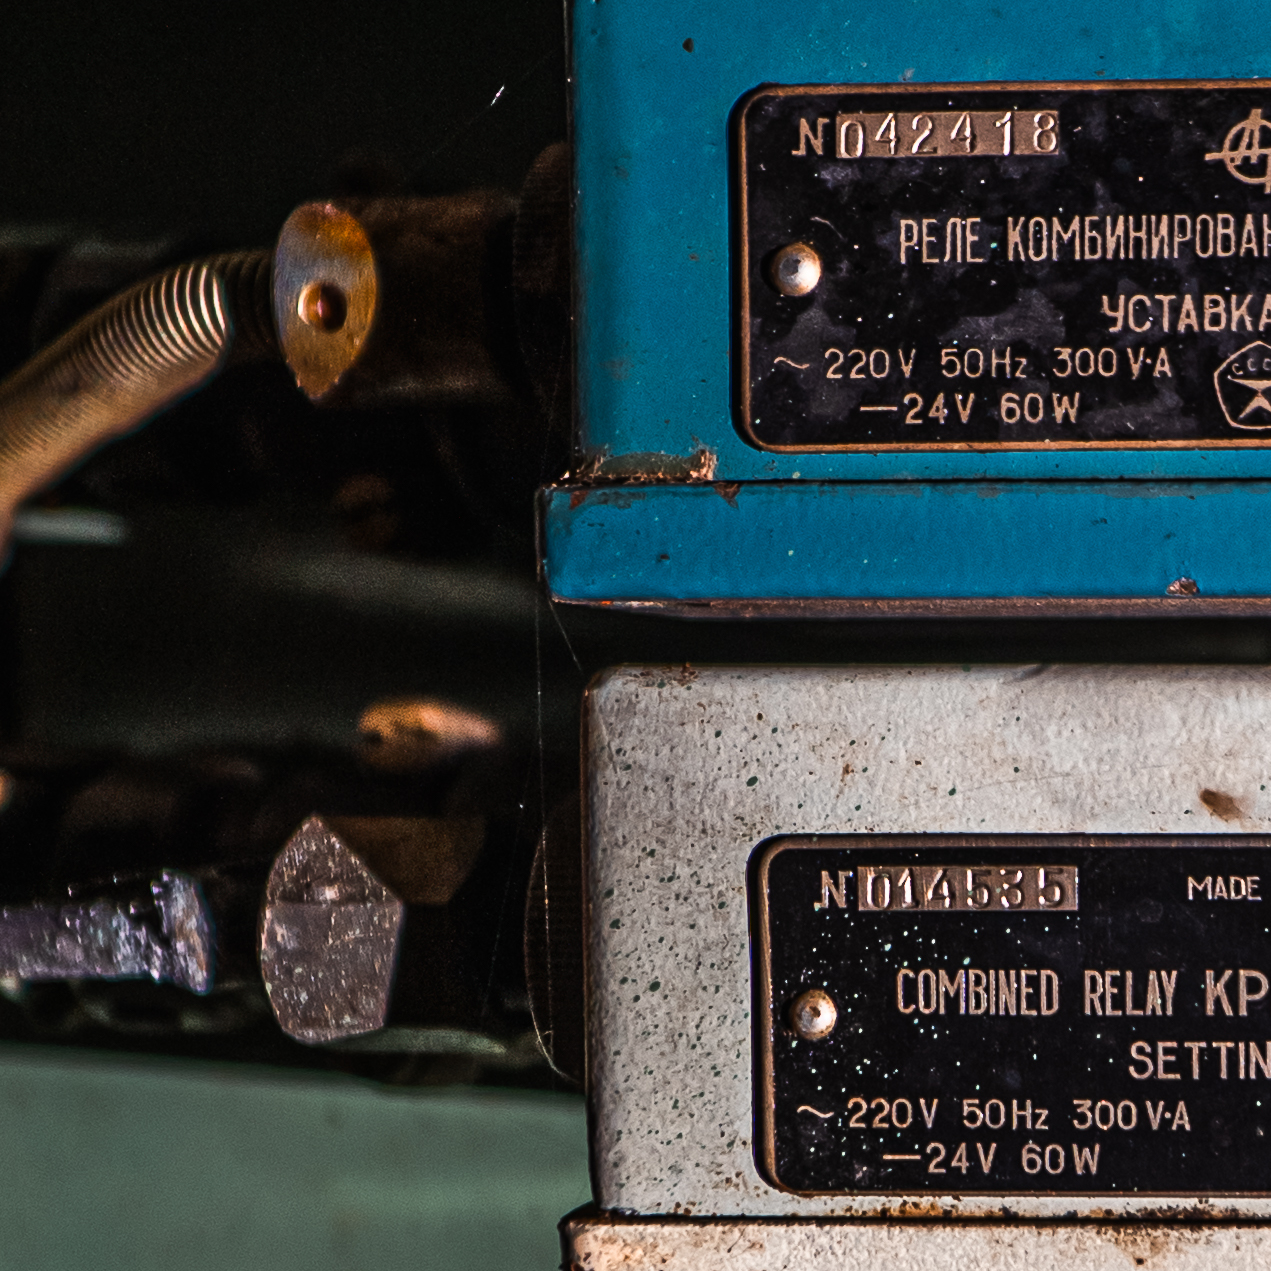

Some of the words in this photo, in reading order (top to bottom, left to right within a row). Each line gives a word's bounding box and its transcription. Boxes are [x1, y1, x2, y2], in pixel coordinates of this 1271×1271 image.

[899, 217, 985, 264] РЕЛЕ
[1187, 875, 1262, 900] MADE
[896, 969, 1059, 1015] COMBINED
[1084, 970, 1178, 1016] RELAY
